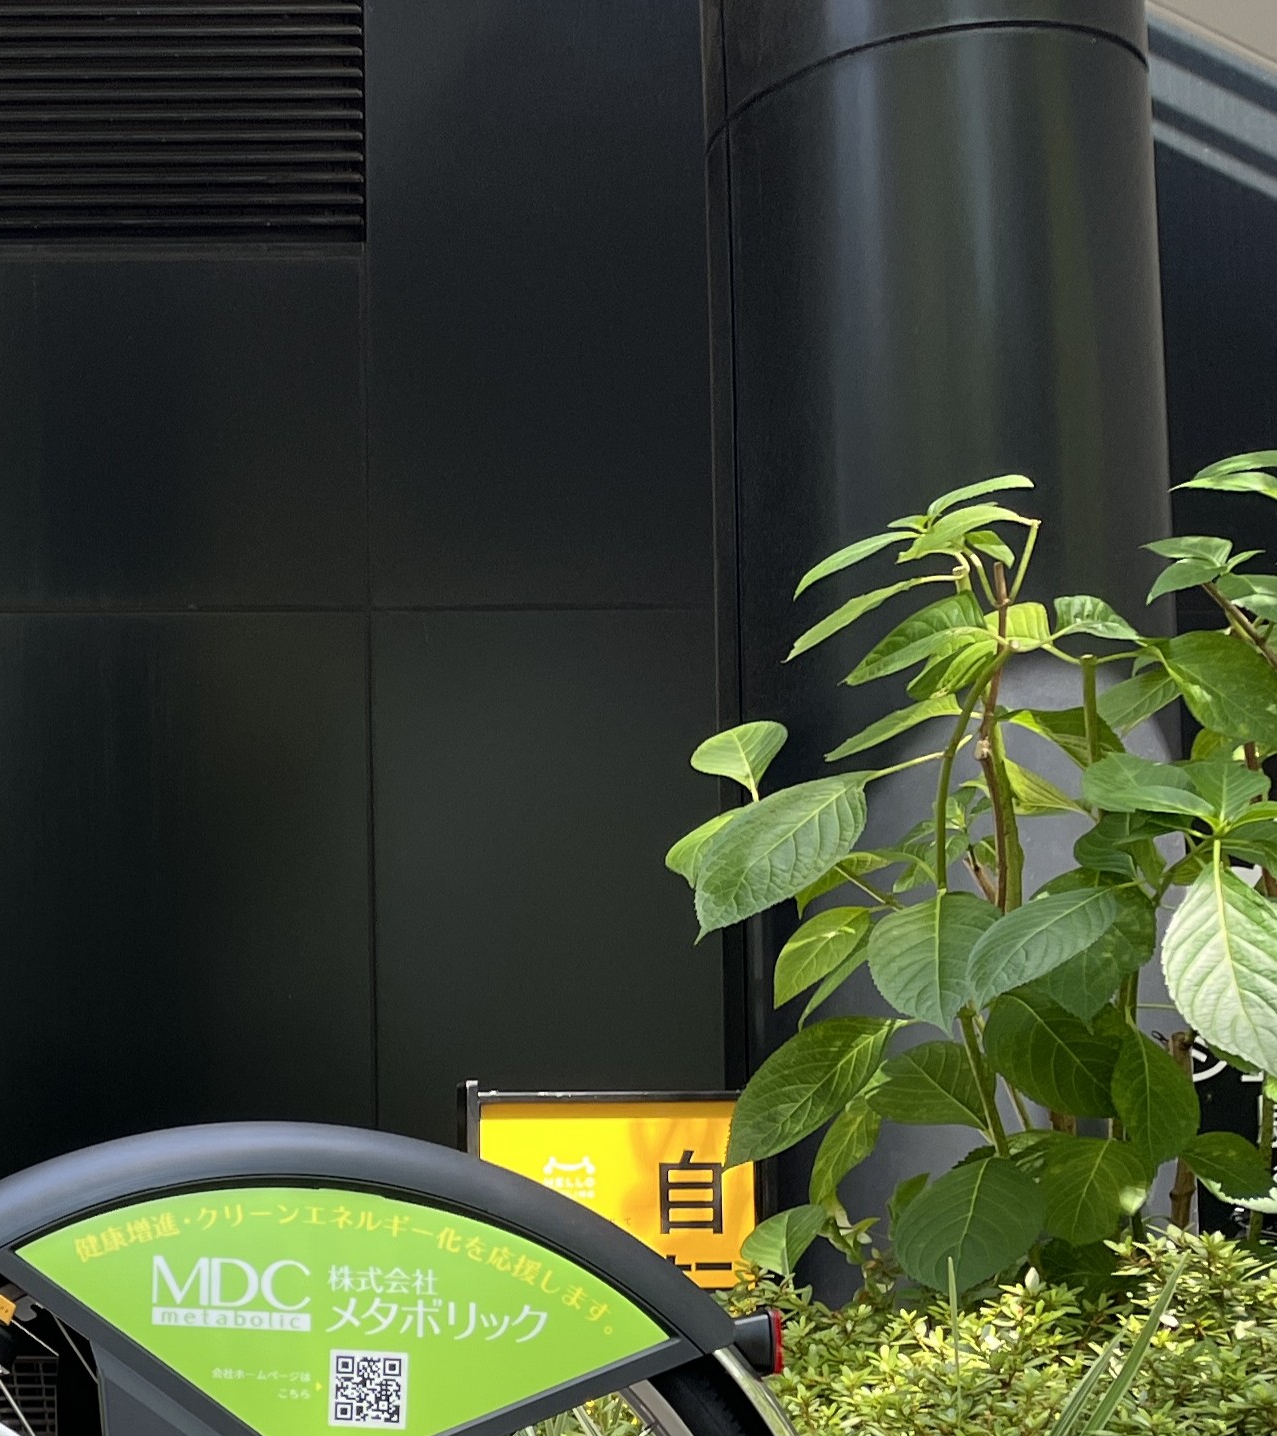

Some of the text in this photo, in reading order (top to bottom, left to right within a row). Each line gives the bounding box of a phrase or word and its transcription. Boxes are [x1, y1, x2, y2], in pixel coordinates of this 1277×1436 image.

[151, 1254, 312, 1312] MDC
[327, 1263, 439, 1296] 株式会社
[158, 1308, 305, 1331] metabolic
[325, 1296, 548, 1344] メタボリック
